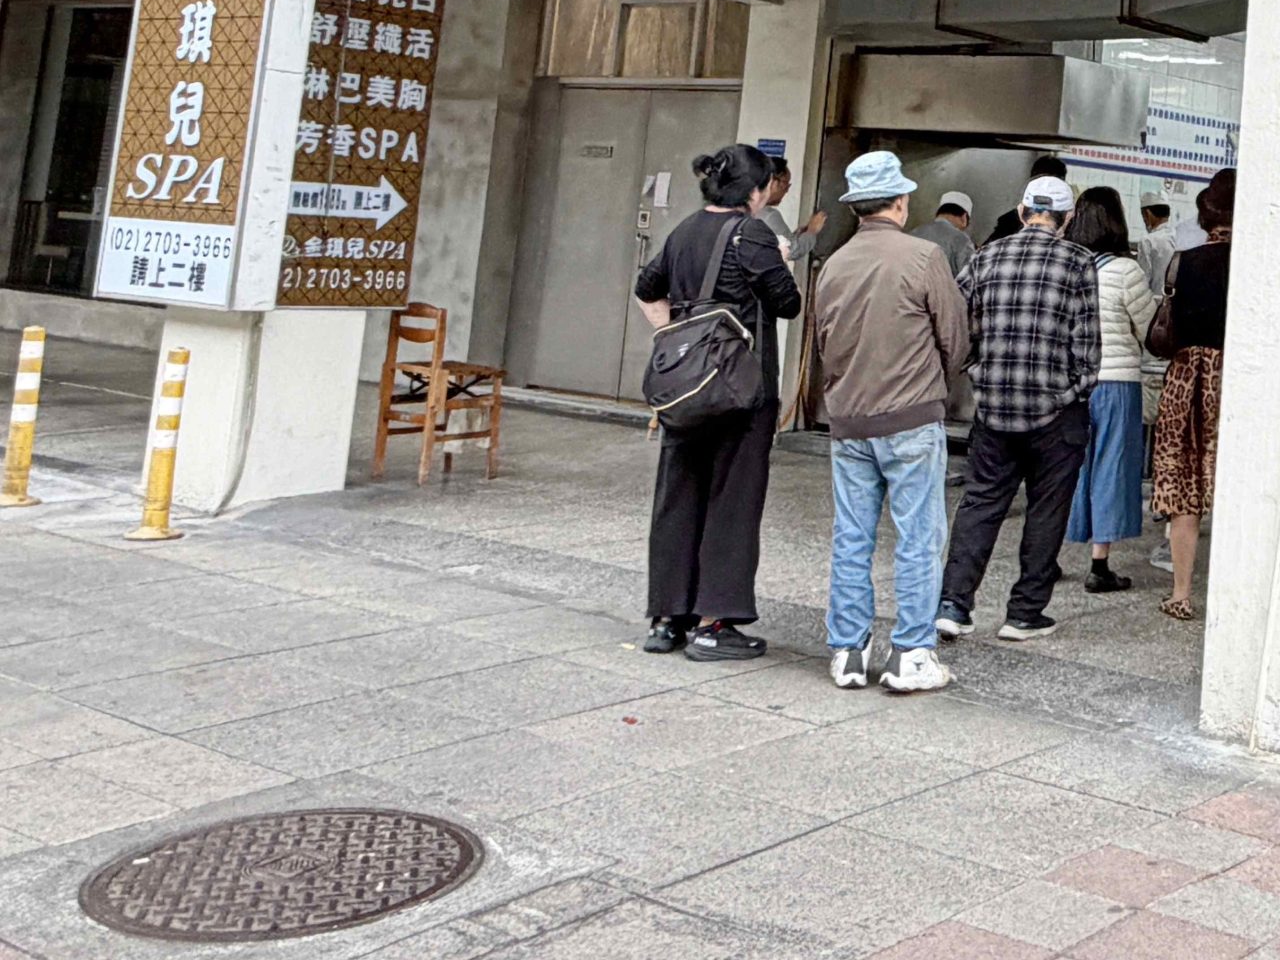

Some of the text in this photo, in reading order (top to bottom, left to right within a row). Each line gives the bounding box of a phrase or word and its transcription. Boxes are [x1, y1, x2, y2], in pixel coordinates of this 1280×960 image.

[126, 153, 225, 204] SPA
[110, 227, 232, 259] (02)2703-3966
[129, 255, 207, 292] 請上二樓
